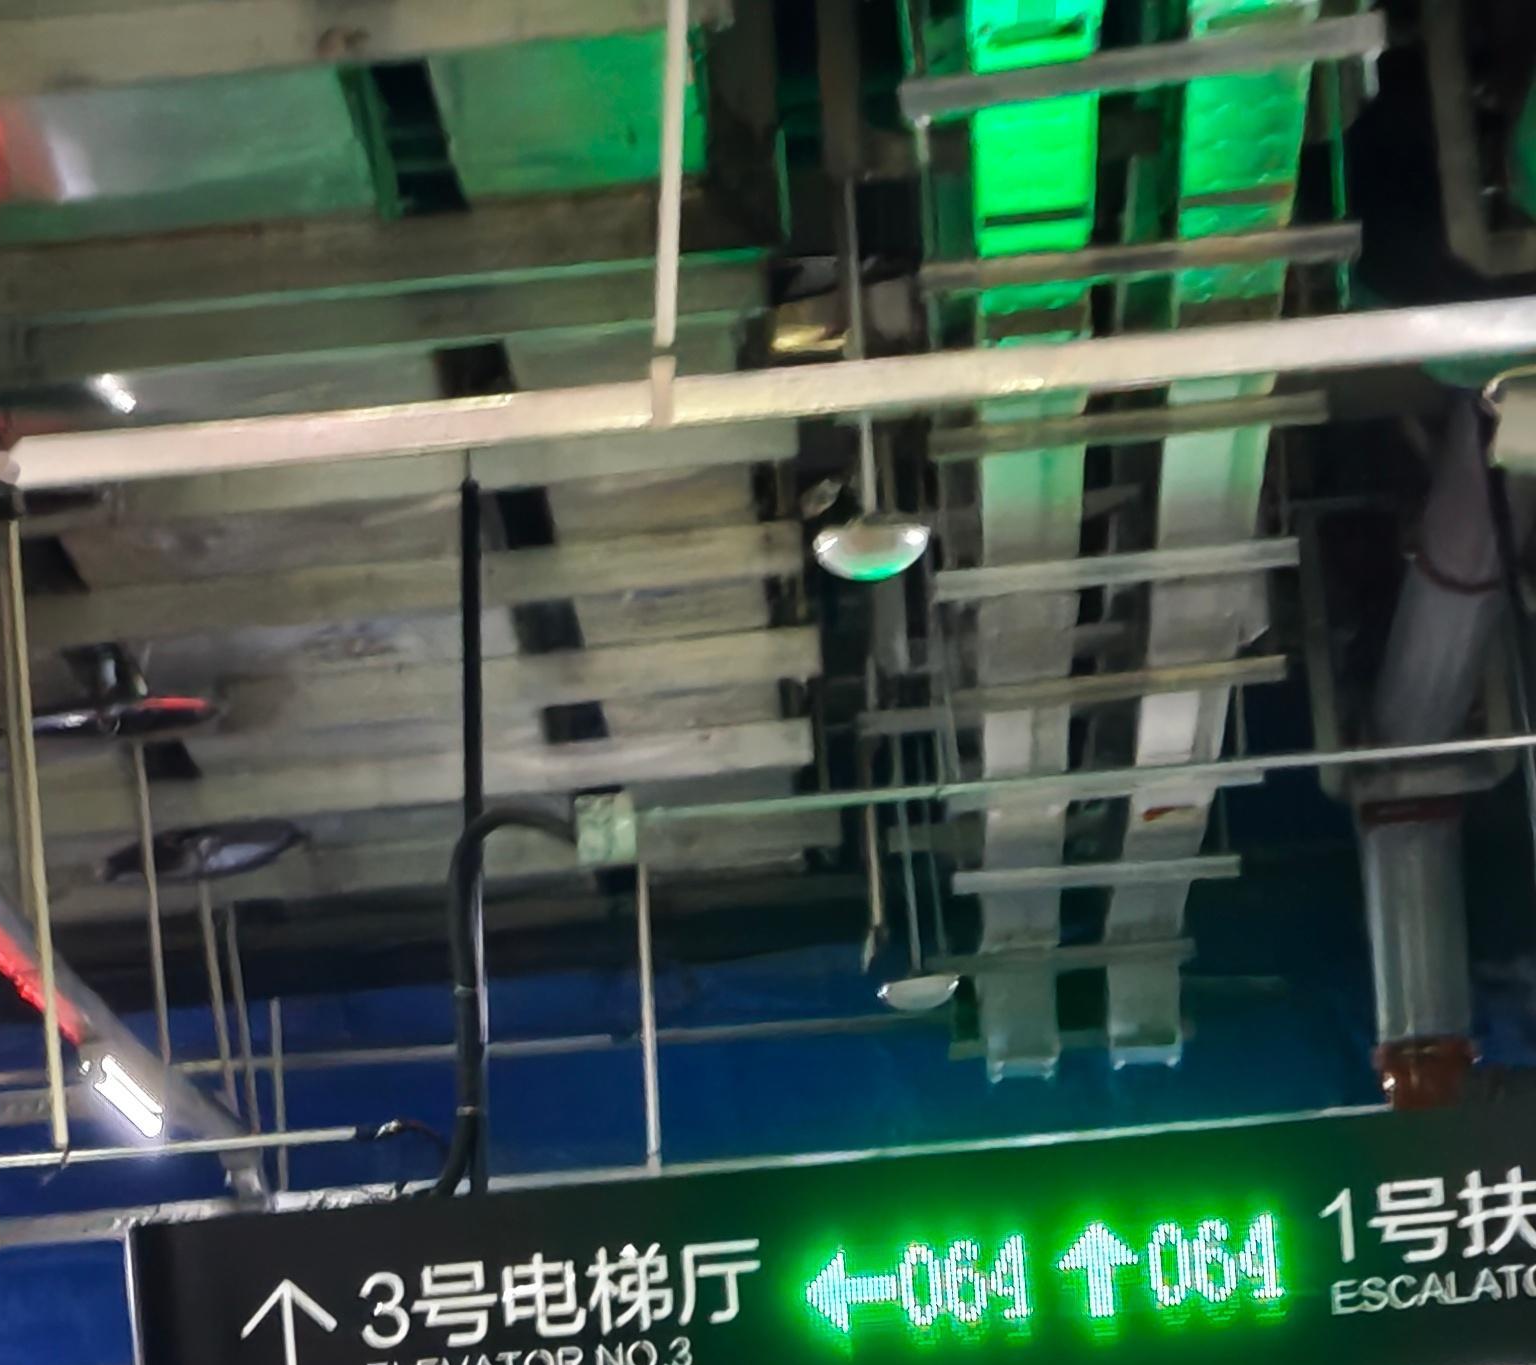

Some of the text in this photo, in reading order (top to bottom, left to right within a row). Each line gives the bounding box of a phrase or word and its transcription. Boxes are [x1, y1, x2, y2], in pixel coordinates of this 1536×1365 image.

[1148, 1211, 1284, 1308] 064
[1318, 1164, 1536, 1264] 1号扶
[358, 1238, 760, 1350] 3号电梯厅
[898, 1233, 1033, 1327] 064
